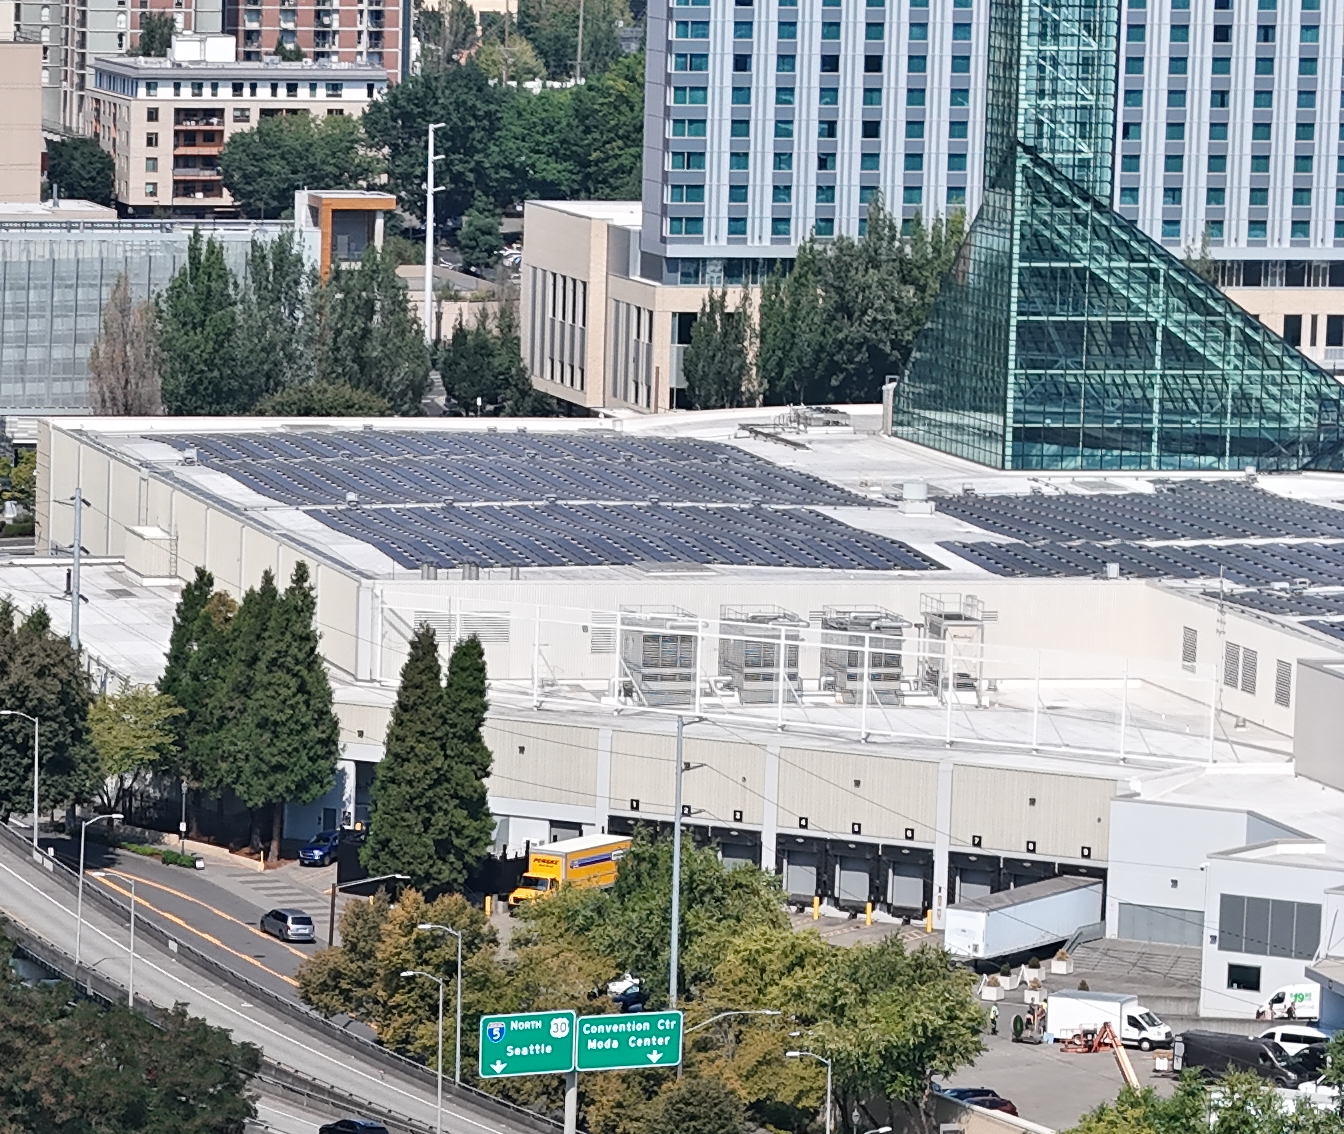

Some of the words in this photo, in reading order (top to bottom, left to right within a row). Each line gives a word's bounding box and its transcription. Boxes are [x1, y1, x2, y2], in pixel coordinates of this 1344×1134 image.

[492, 1028, 500, 1040] 5
[510, 1019, 542, 1031] NORTH
[552, 1021, 568, 1034] 30
[582, 1020, 650, 1035] Convention
[657, 1018, 677, 1031] Ctr
[506, 1043, 553, 1057] Seattle
[587, 1038, 619, 1050] Moda
[628, 1034, 671, 1048] Center
